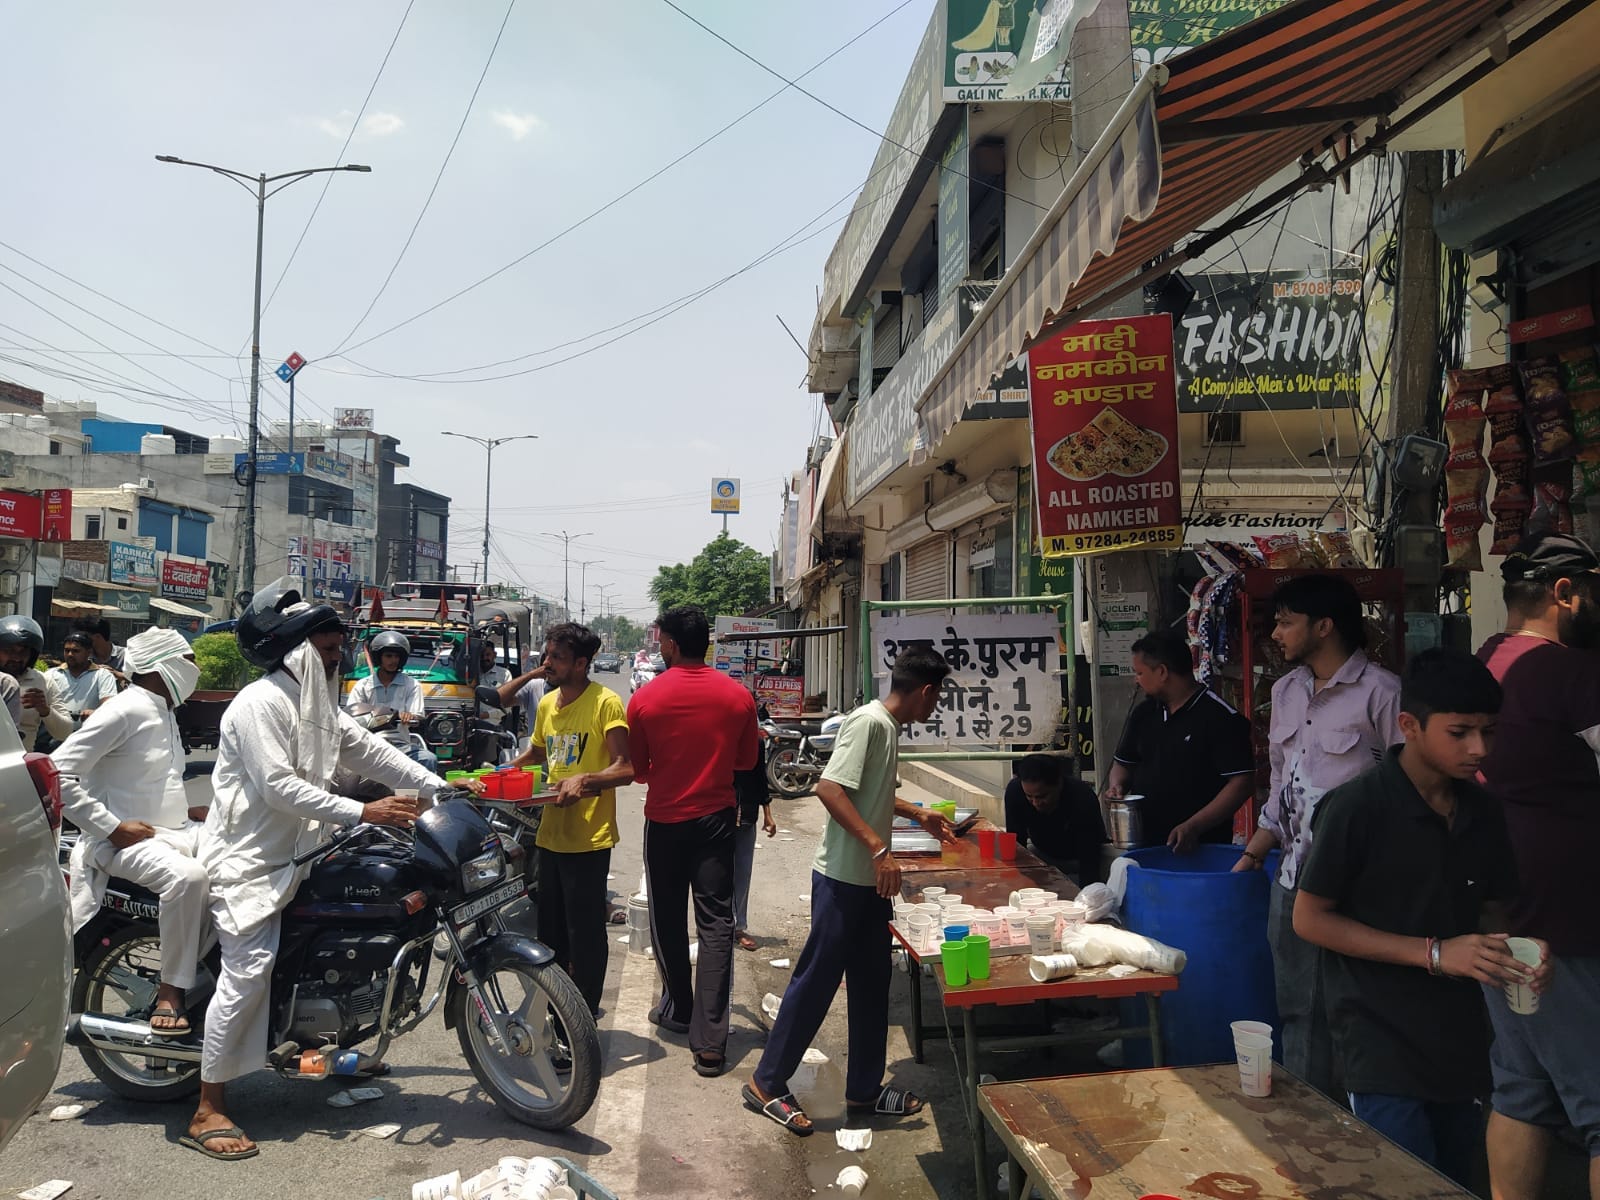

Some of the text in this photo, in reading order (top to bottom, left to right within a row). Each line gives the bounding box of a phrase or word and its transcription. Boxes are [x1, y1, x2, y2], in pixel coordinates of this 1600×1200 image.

[957, 89, 984, 100] GALI
[1273, 282, 1289, 298] M.
[1061, 325, 1138, 353] माही
[1035, 351, 1168, 381] नमकीन
[1256, 374, 1295, 394] Men's
[977, 392, 993, 401] ANT
[1001, 391, 1026, 401] SHIRT
[1053, 382, 1157, 407] भण्डार
[1048, 481, 1174, 508] ALL ROASTED
[1067, 507, 1160, 531] NAMKEEN
[1228, 512, 1324, 528] Fashion
[1052, 529, 1176, 553] M. 97284-24885
[1038, 559, 1066, 577] House
[117, 599, 139, 611] Dulux
[1106, 605, 1141, 613] UCLEAN
[775, 680, 802, 691] EXPRESS
[1013, 677, 1031, 711] 1
[955, 716, 966, 737] 1
[972, 712, 993, 740] से
[999, 715, 1032, 737] 29
